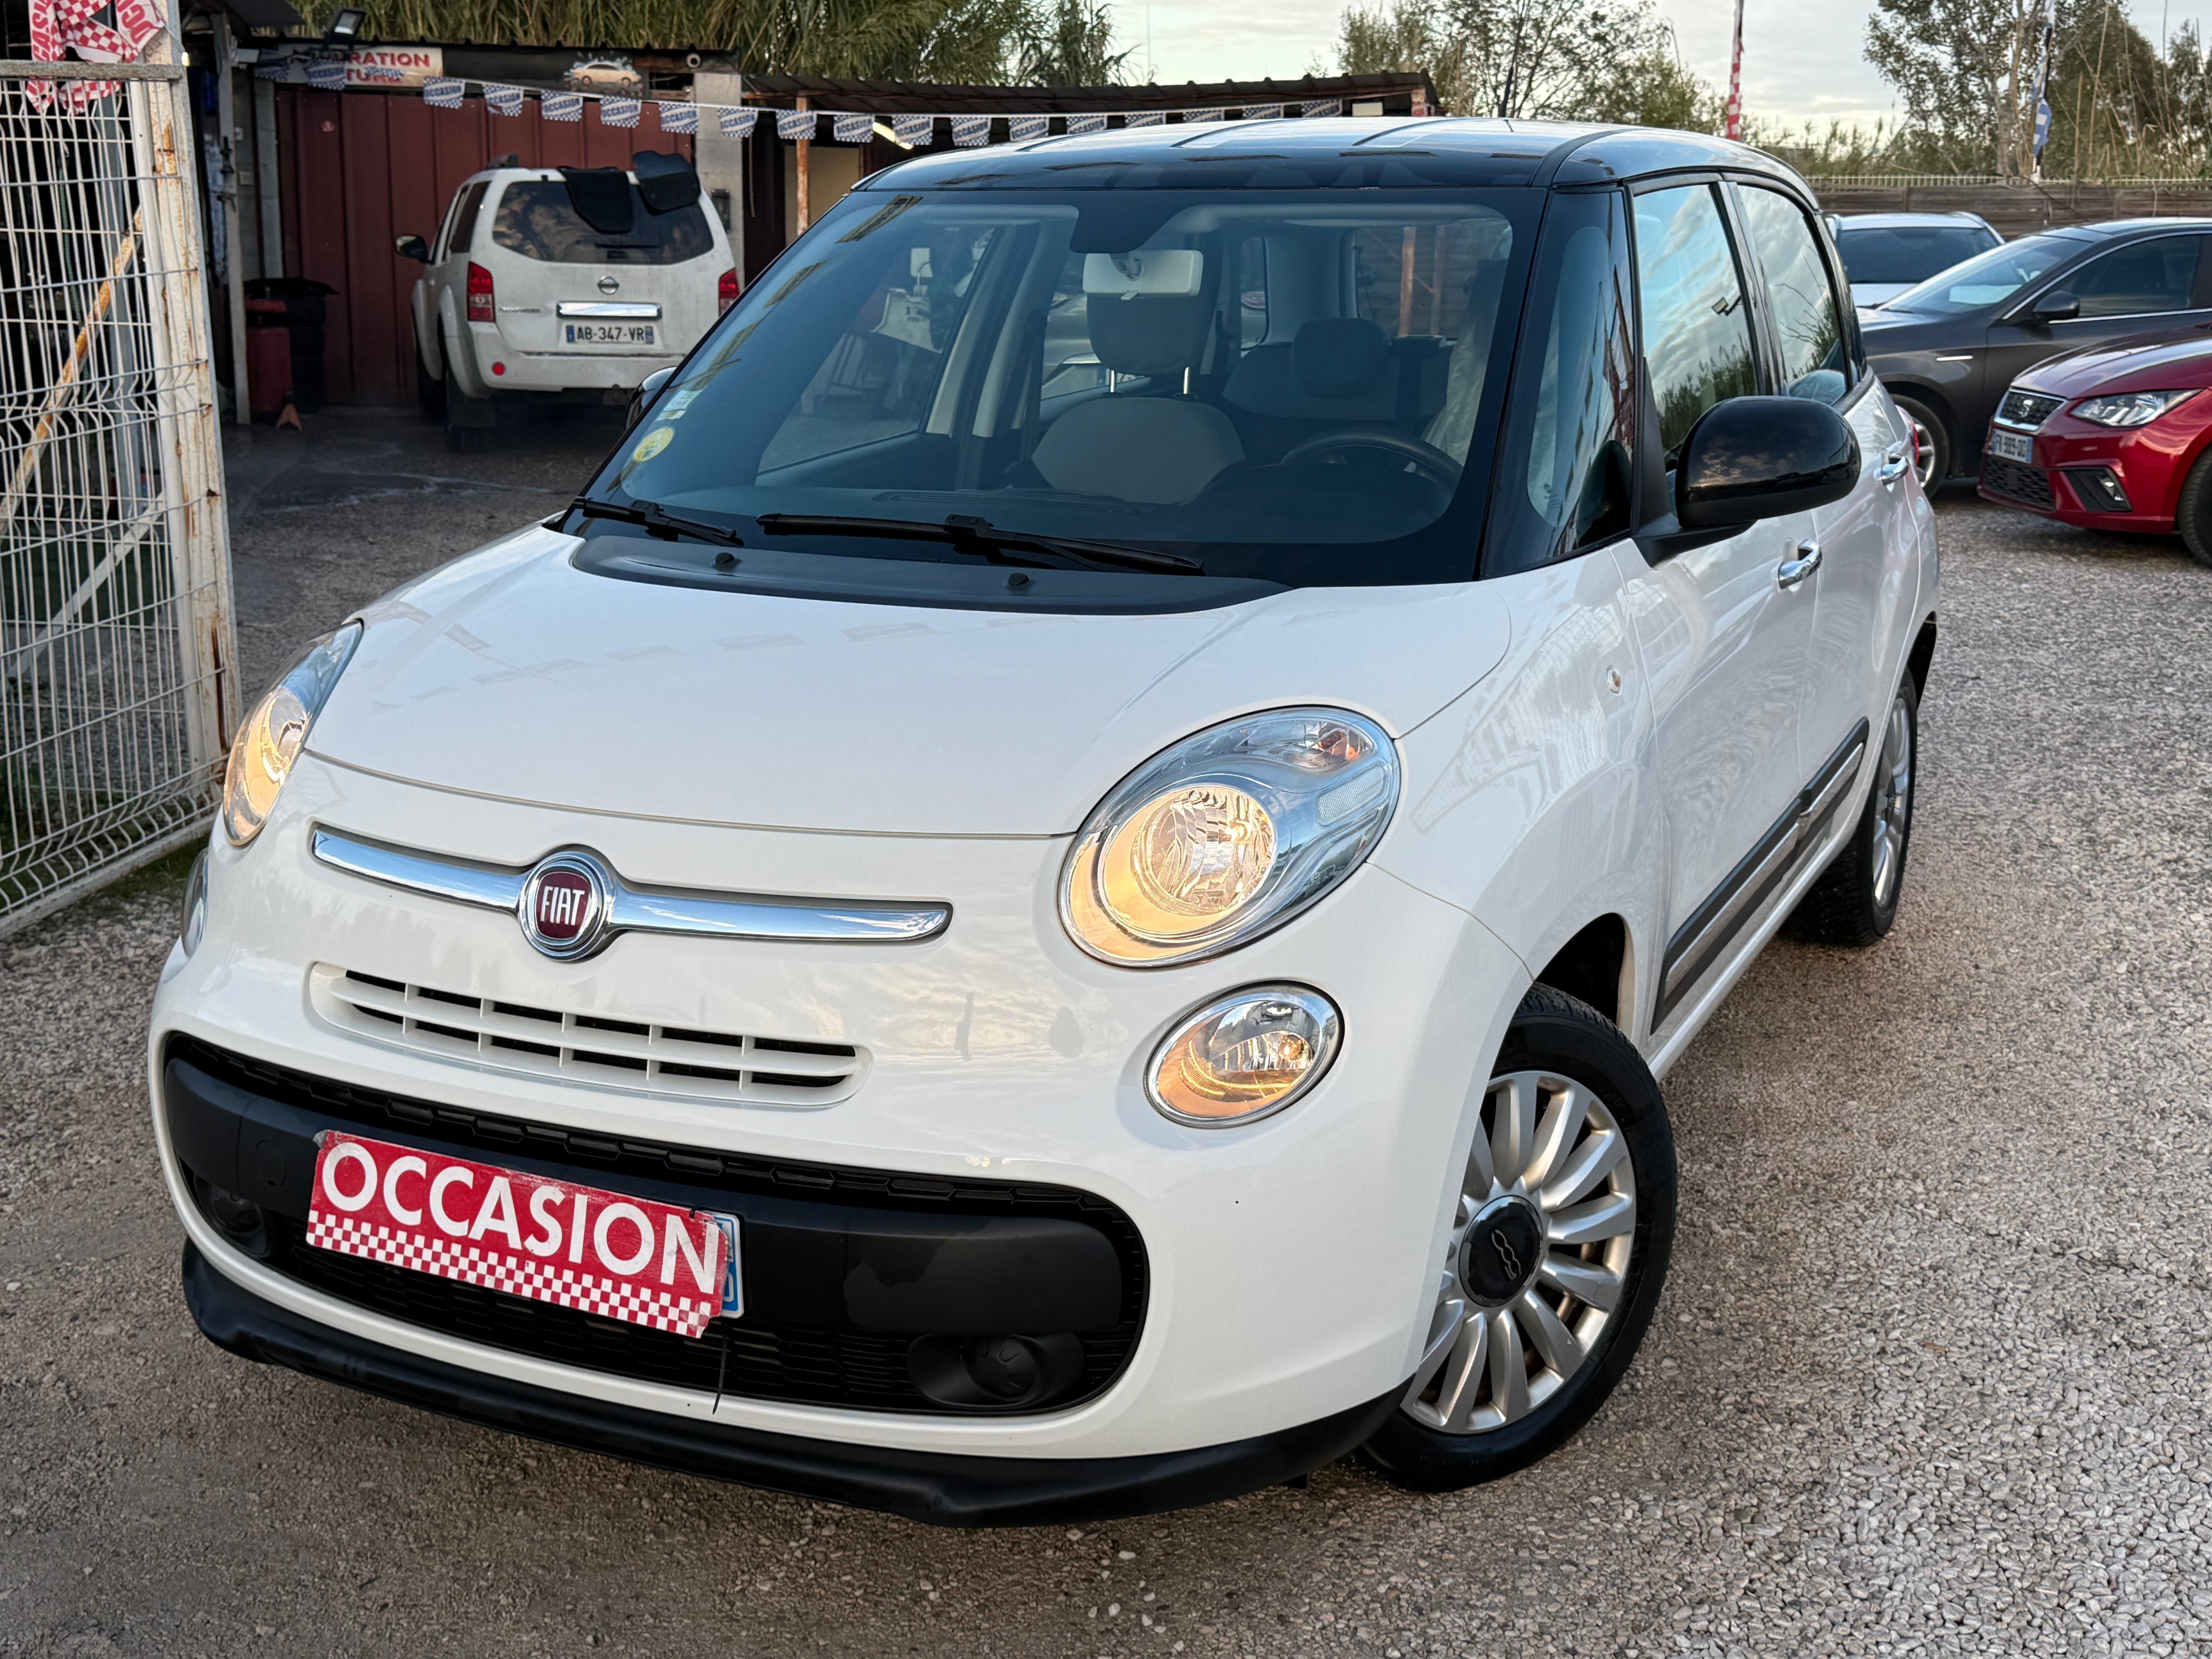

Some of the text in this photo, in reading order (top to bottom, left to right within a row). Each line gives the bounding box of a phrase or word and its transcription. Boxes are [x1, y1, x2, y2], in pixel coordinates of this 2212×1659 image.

[577, 327, 644, 341] AB-347-VR
[540, 886, 585, 926] FIAT
[322, 1142, 720, 1295] OCCASION
